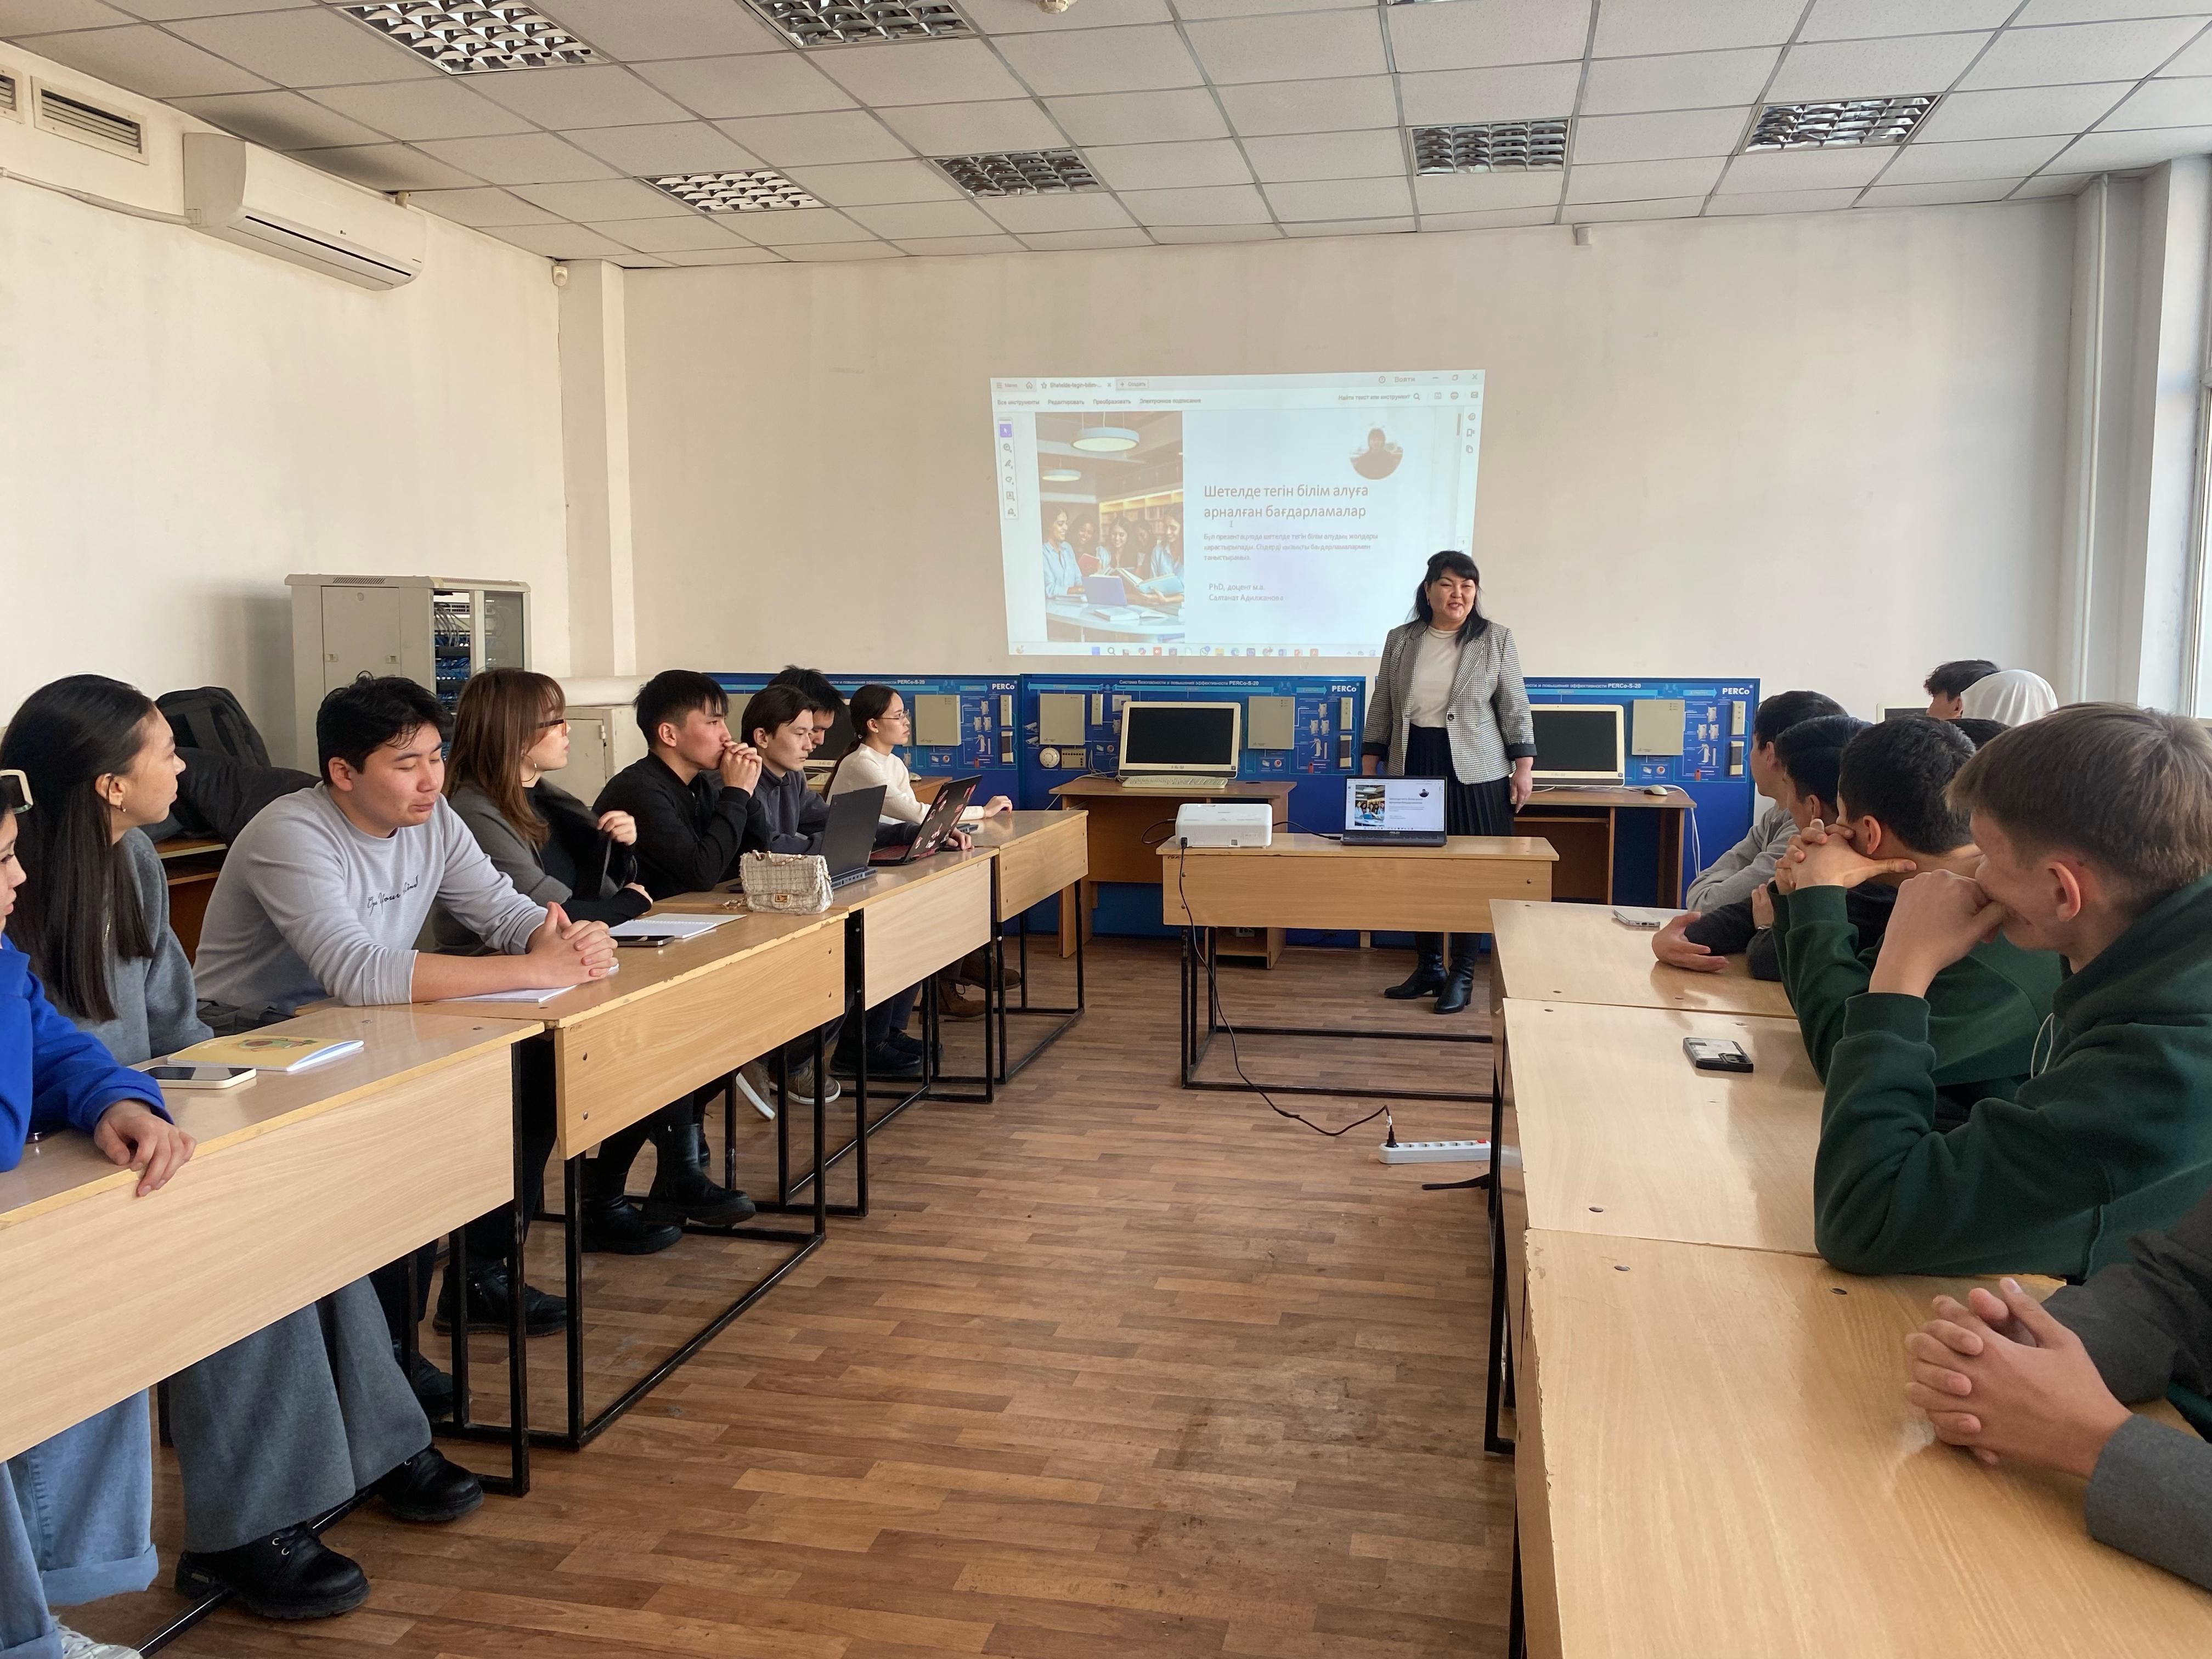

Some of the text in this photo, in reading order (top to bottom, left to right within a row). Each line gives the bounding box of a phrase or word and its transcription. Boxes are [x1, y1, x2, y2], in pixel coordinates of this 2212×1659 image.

[1204, 484, 1368, 499] Шетелде тегін білім алуға
[1204, 505, 1366, 520] арналған бағдарламалар
